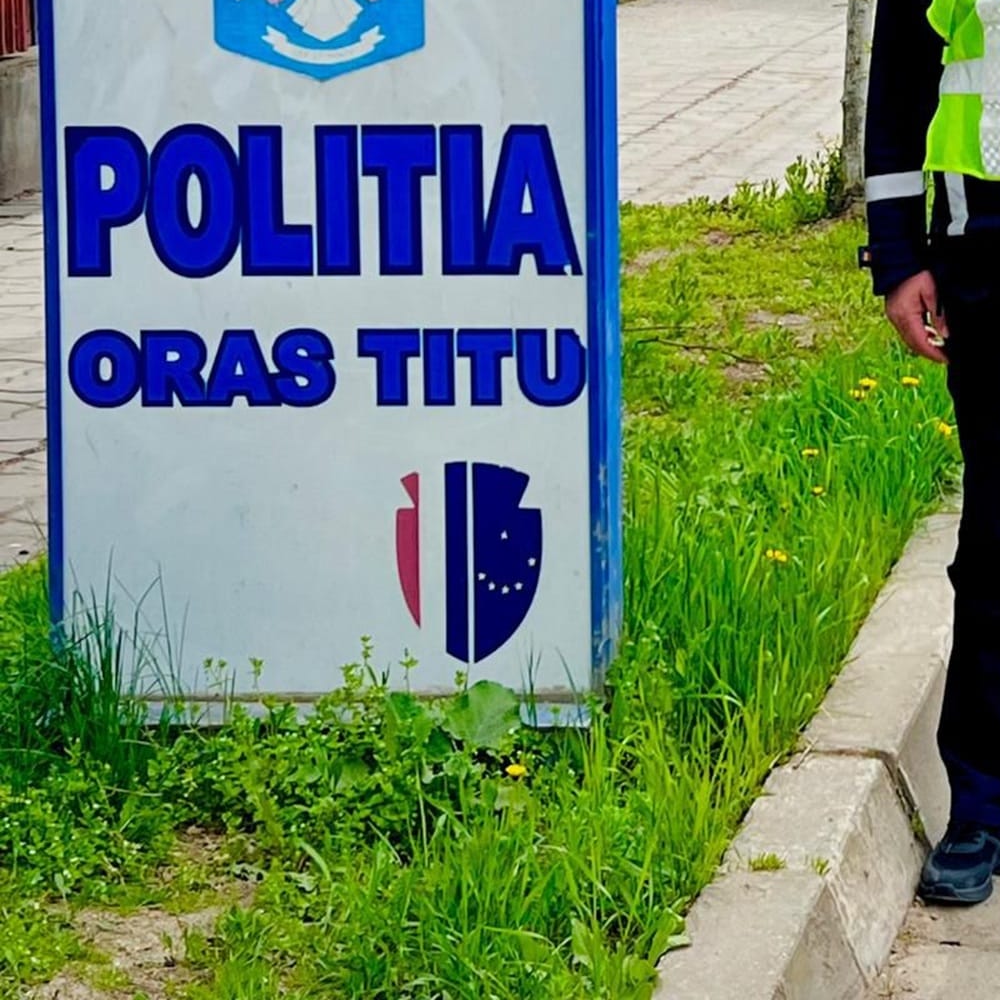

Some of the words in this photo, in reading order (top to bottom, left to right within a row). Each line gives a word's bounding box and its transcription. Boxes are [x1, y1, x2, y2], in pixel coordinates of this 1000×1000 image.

[64, 123, 583, 278] POLITIA
[68, 328, 336, 408] ORAS
[357, 328, 587, 407] TITU
